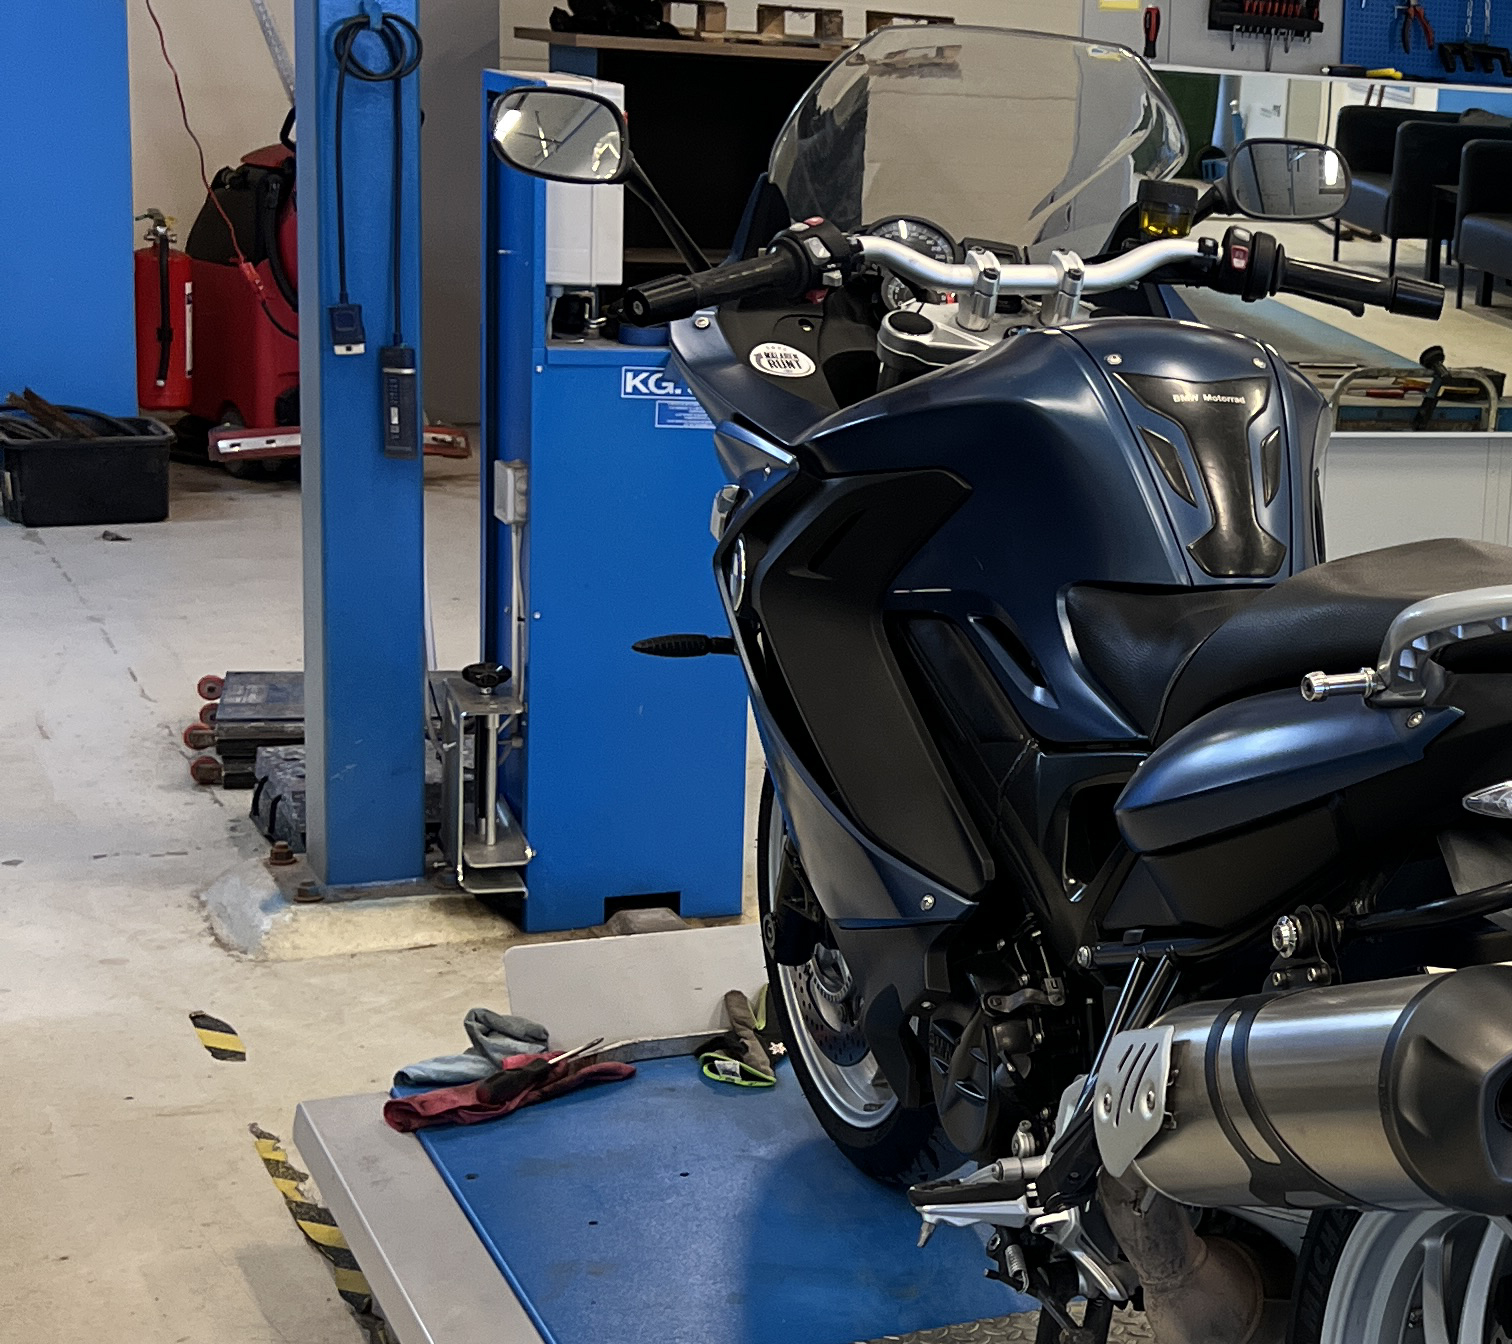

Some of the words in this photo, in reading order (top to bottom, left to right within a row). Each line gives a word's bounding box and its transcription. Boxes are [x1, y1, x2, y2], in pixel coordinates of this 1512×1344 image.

[767, 359, 802, 370] RUNT
[1172, 393, 1199, 403] BMW
[1202, 393, 1247, 405] Motorrad
